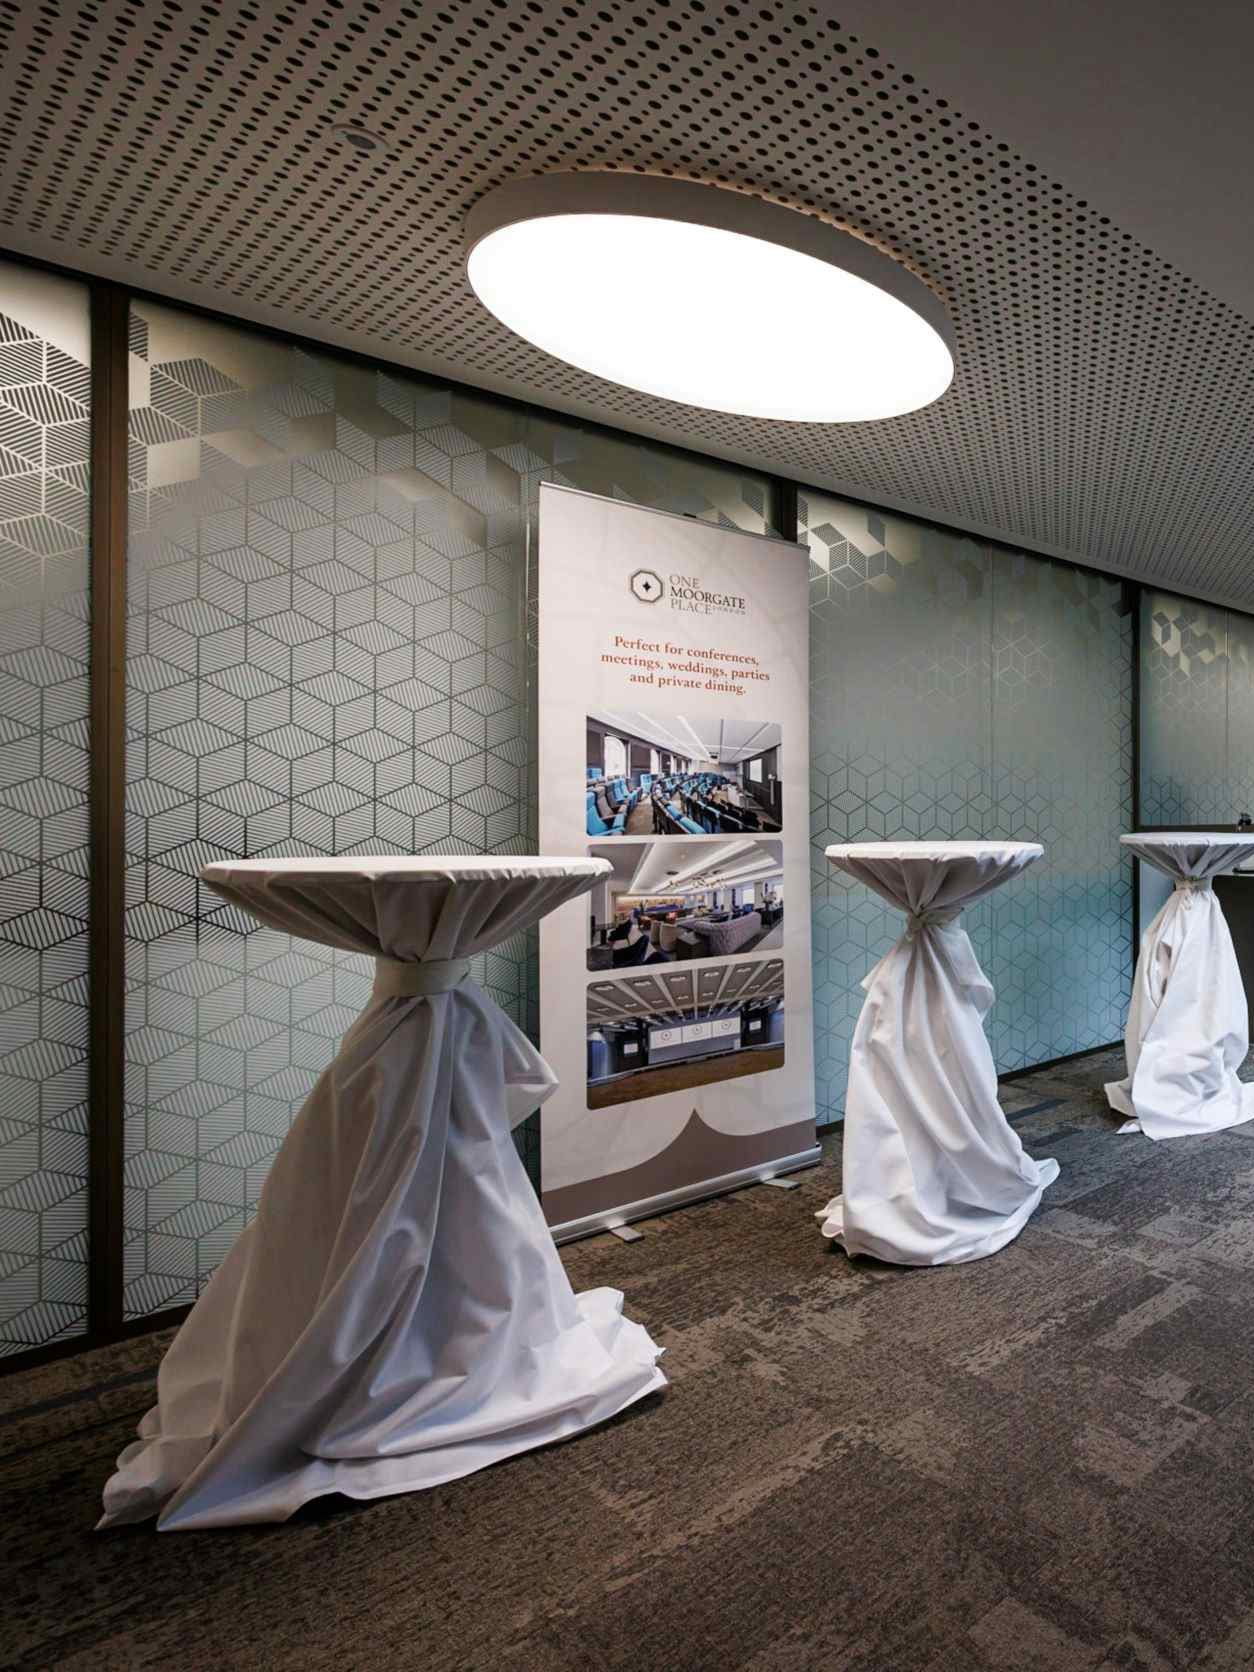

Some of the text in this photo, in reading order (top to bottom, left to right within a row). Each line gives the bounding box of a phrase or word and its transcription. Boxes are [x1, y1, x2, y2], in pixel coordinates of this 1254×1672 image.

[669, 575, 700, 589] ONE
[670, 586, 745, 609] MOORGATE
[671, 598, 712, 615] PLACE
[615, 635, 759, 666] Perfect for conferences,
[630, 673, 654, 684] and
[658, 675, 702, 689] private
[731, 669, 770, 681] parties
